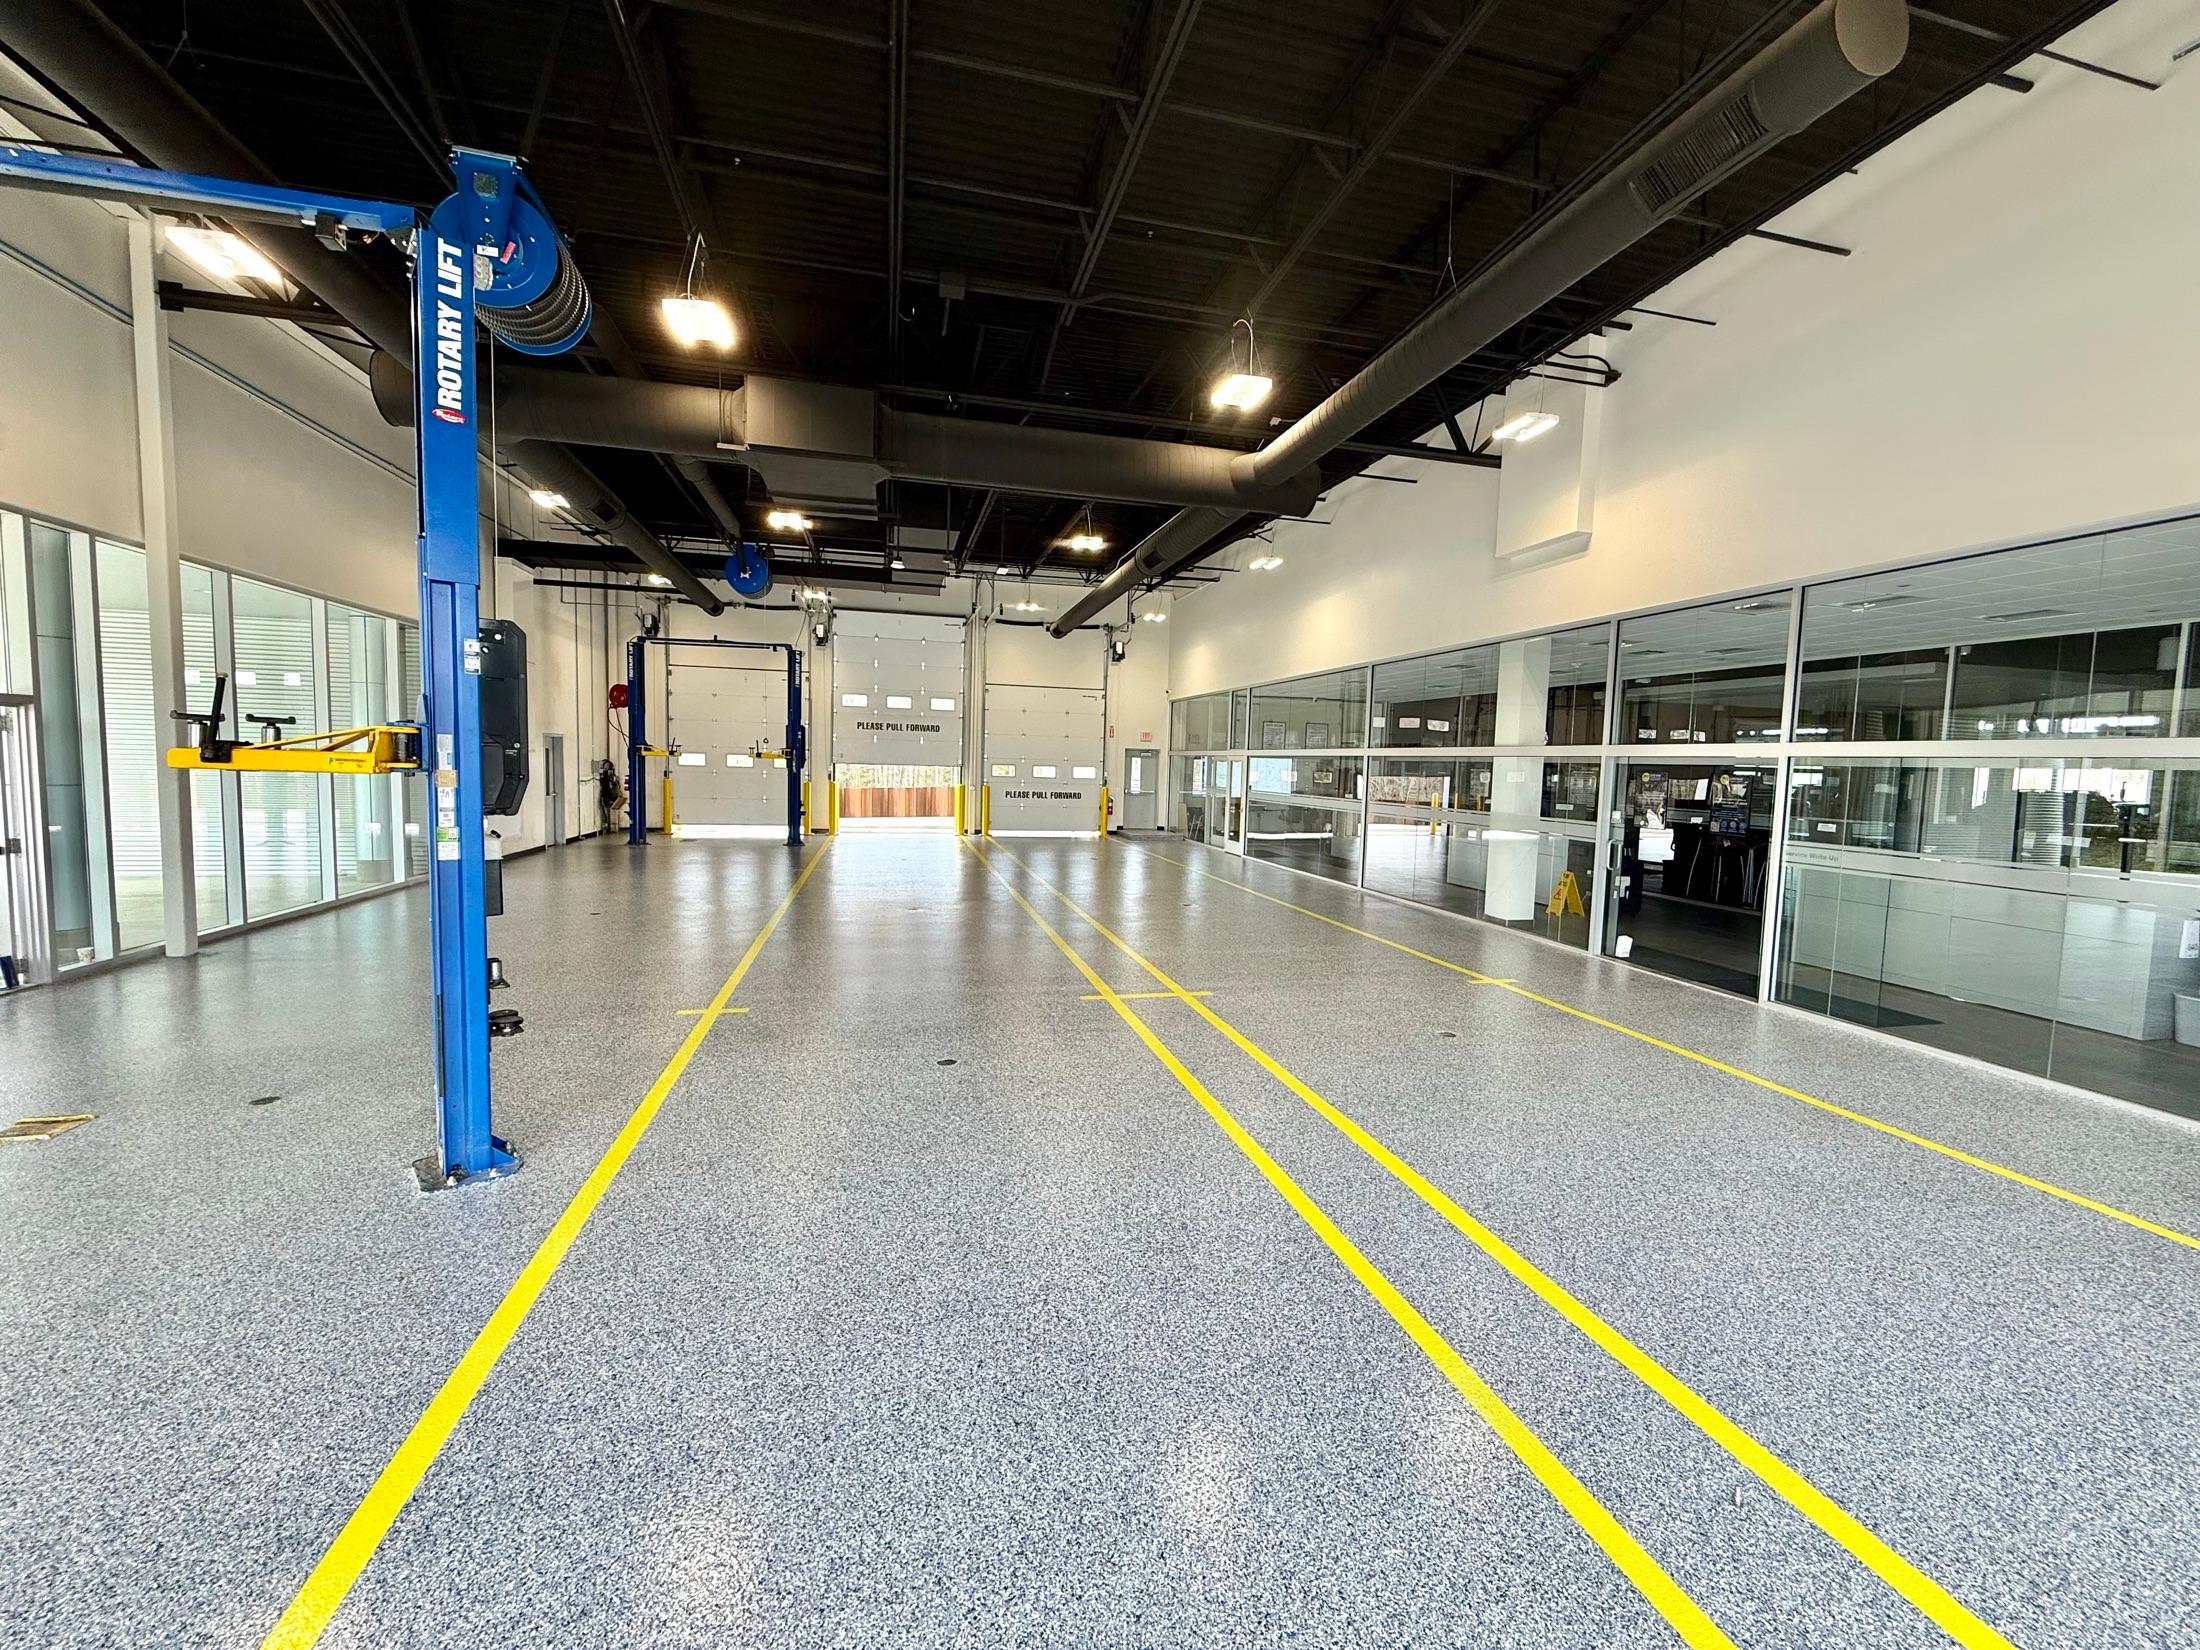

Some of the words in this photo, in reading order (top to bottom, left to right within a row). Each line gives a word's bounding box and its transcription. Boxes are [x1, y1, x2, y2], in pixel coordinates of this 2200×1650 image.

[437, 237, 462, 299] LIFT
[437, 299, 462, 411] ROTARY
[857, 721, 885, 731] PLEASE
[886, 722, 904, 732] PULL
[906, 723, 941, 733] FORWARD
[1005, 790, 1030, 799] PLEASE
[1031, 791, 1048, 799] PULL
[1050, 791, 1082, 800] FORWARD
